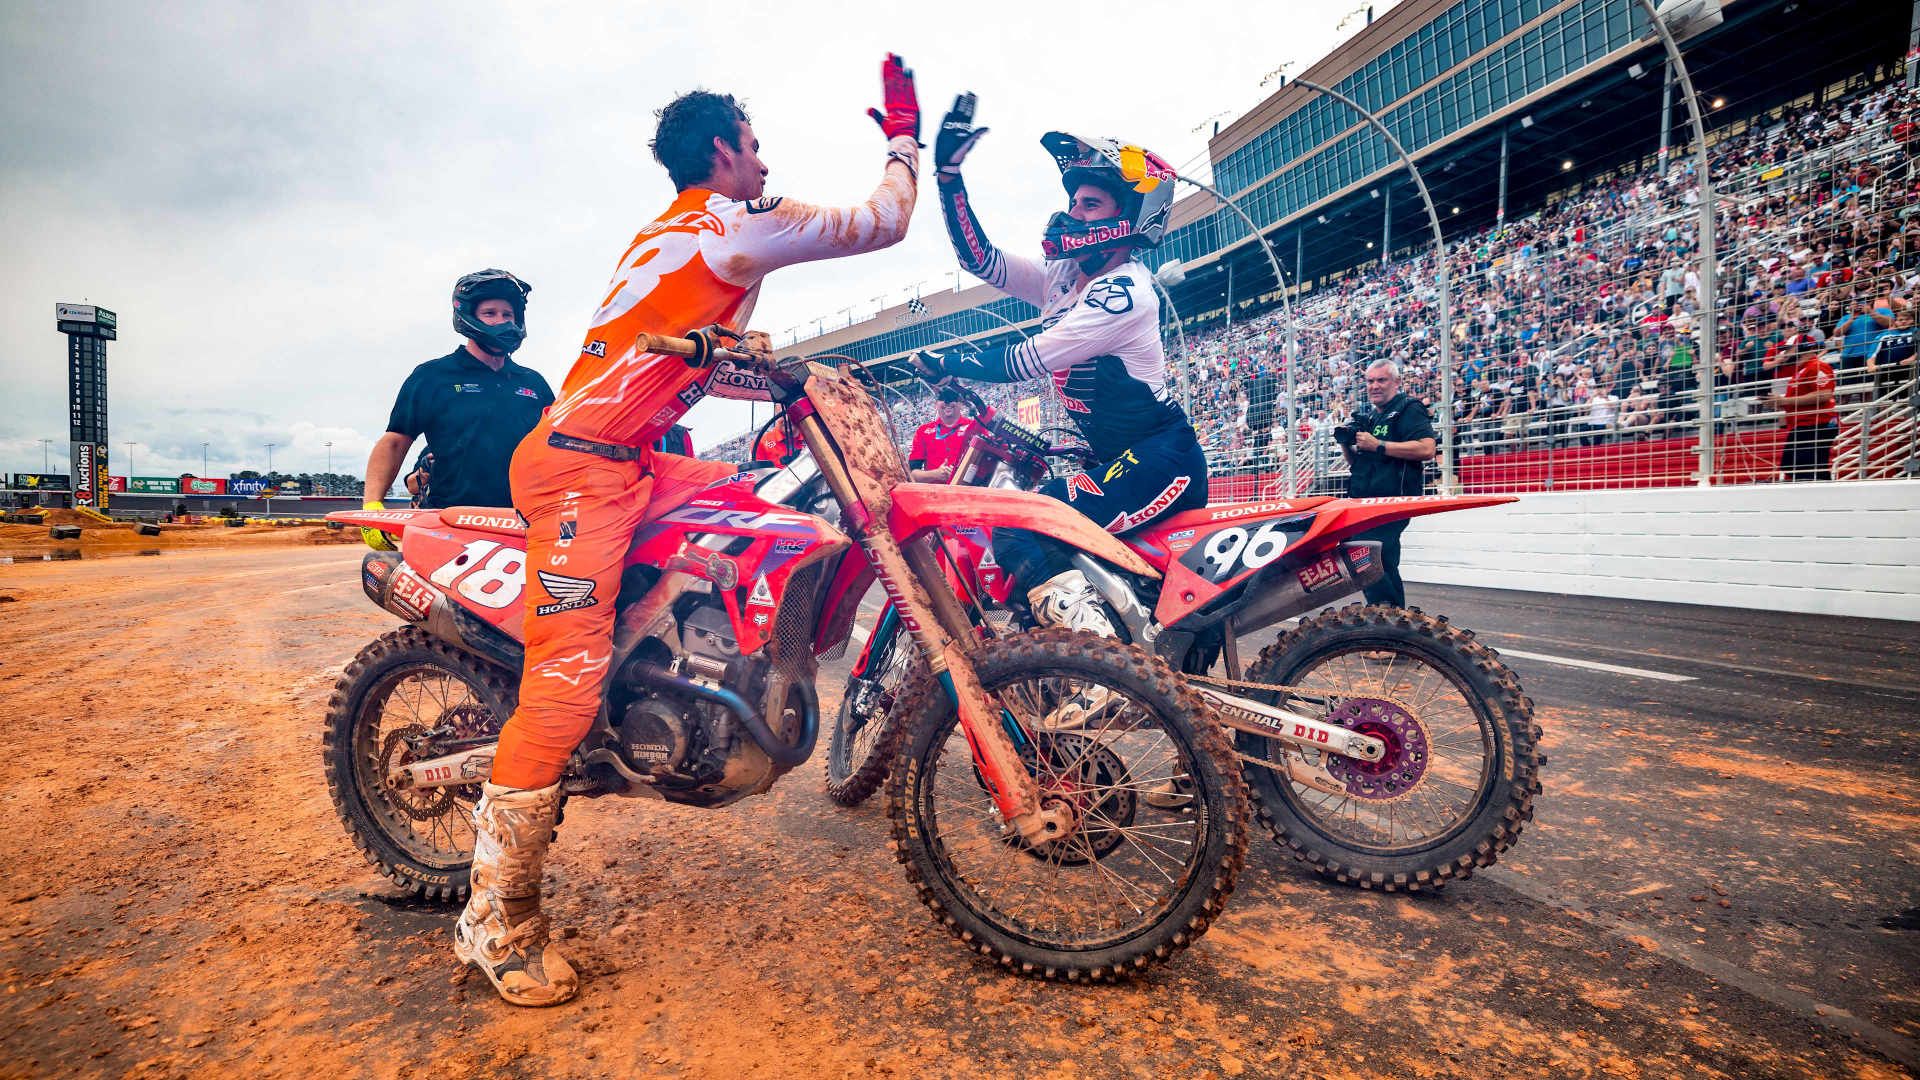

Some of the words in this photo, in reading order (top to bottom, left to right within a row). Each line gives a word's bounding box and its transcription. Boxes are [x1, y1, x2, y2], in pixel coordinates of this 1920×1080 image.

[1061, 228, 1097, 251] Red
[1097, 220, 1131, 243] Bull
[1019, 404, 1040, 425] EXIT
[1373, 425, 1388, 436] 54
[233, 480, 266, 494] xfinity
[1128, 479, 1188, 526] HONDA
[1211, 502, 1294, 520] HONDA
[456, 514, 526, 530] HONDA
[658, 507, 812, 529] CRF
[1204, 523, 1288, 582] 96
[430, 539, 527, 609] 18
[538, 598, 597, 615] HONDA
[394, 863, 449, 884] DUNLOP
